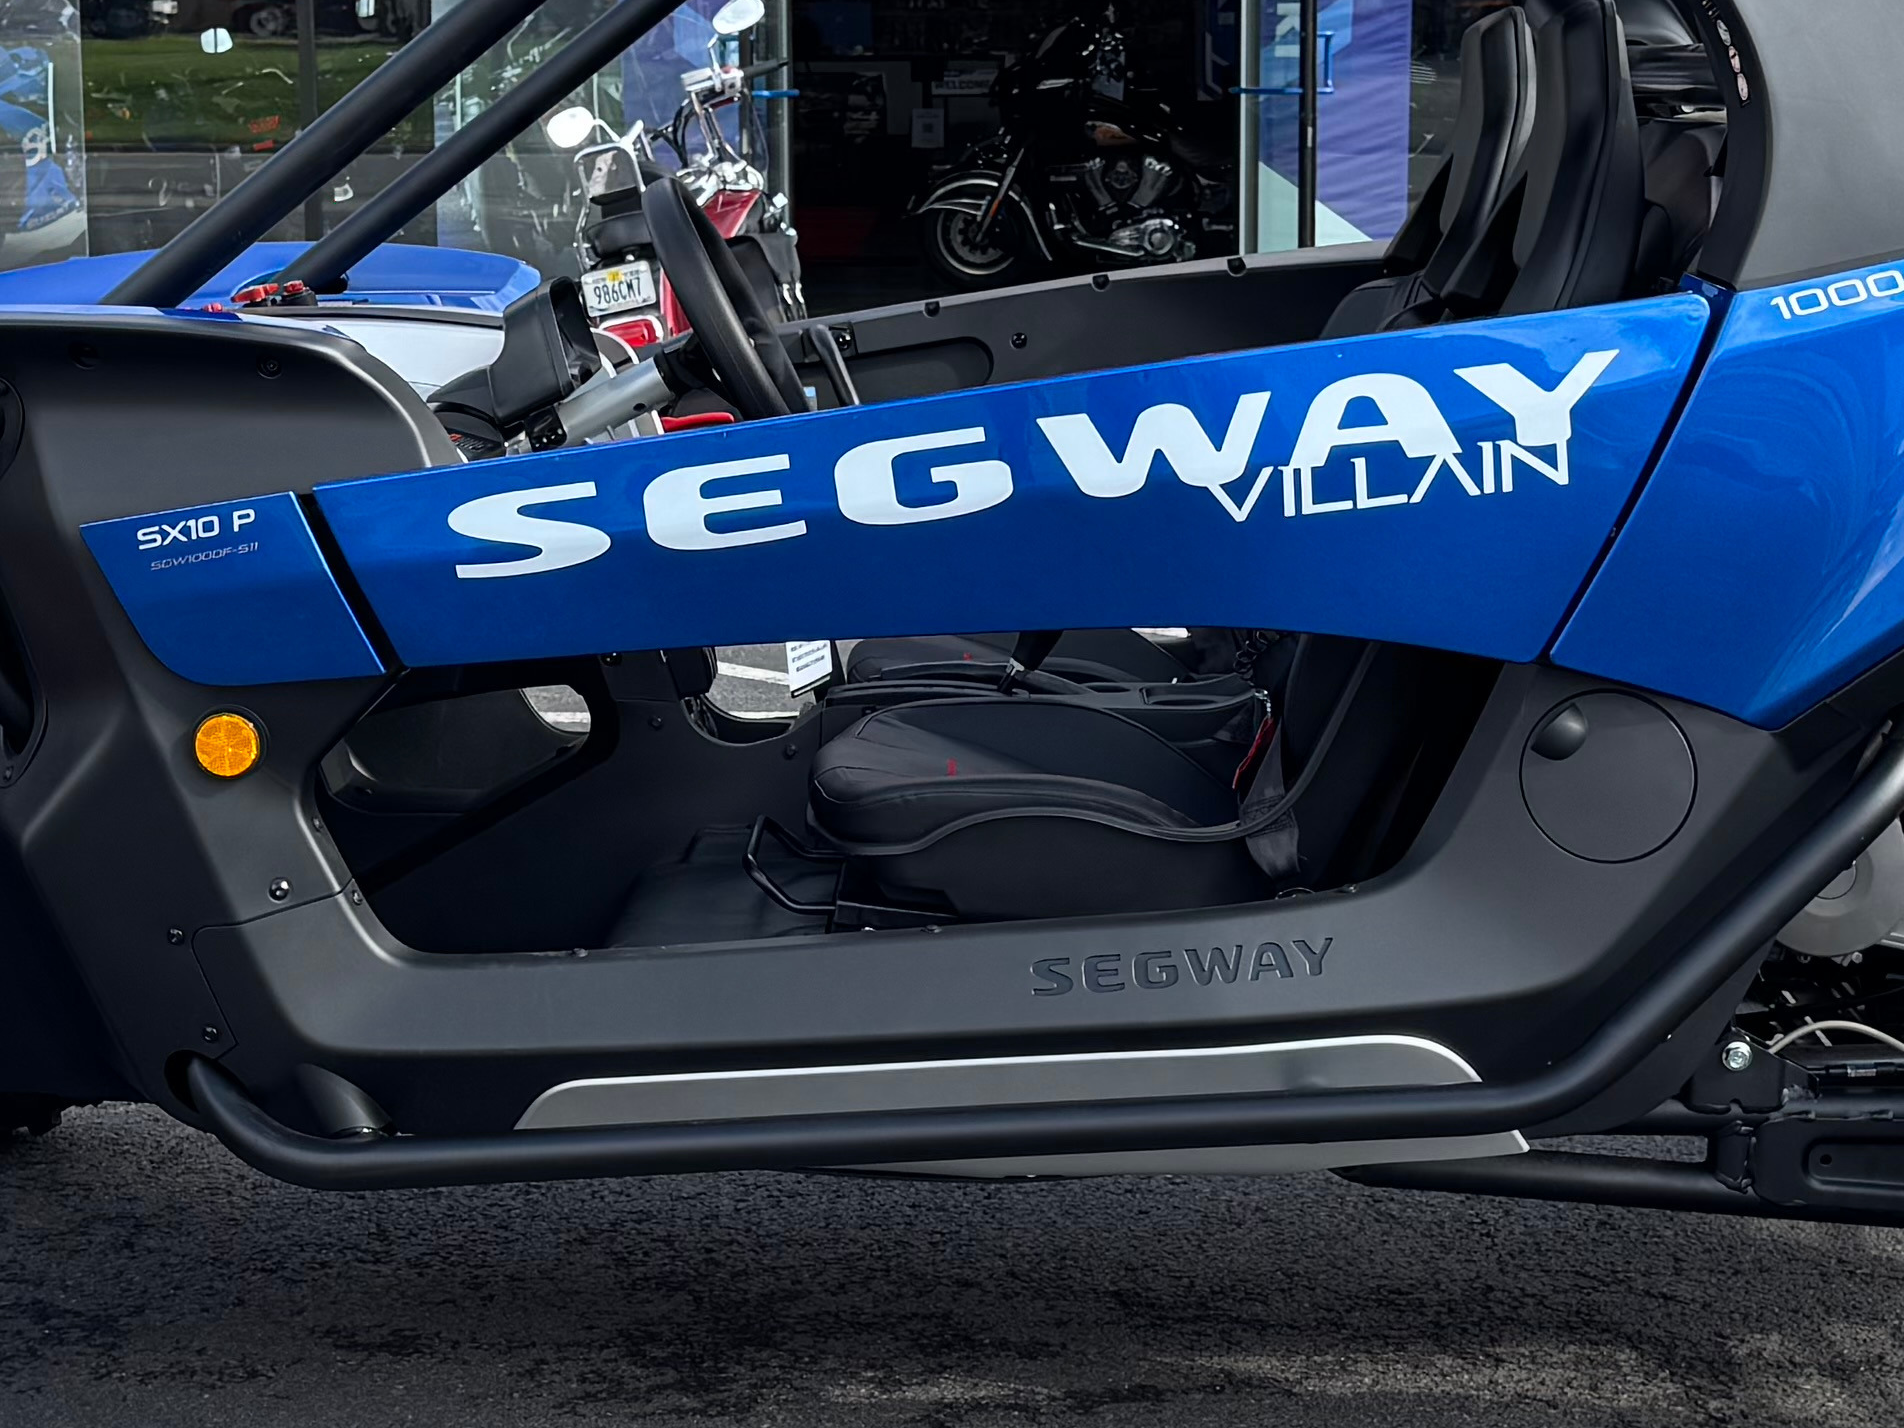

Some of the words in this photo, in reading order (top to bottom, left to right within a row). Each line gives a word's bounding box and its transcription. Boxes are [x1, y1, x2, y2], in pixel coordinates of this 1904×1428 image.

[592, 277, 642, 305] 986CM7
[447, 348, 1621, 579] SEGWAY
[1204, 439, 1572, 523] VILLAIN
[136, 515, 220, 550] SX10
[232, 508, 255, 532] P
[1029, 937, 1334, 997] SEGWAY
